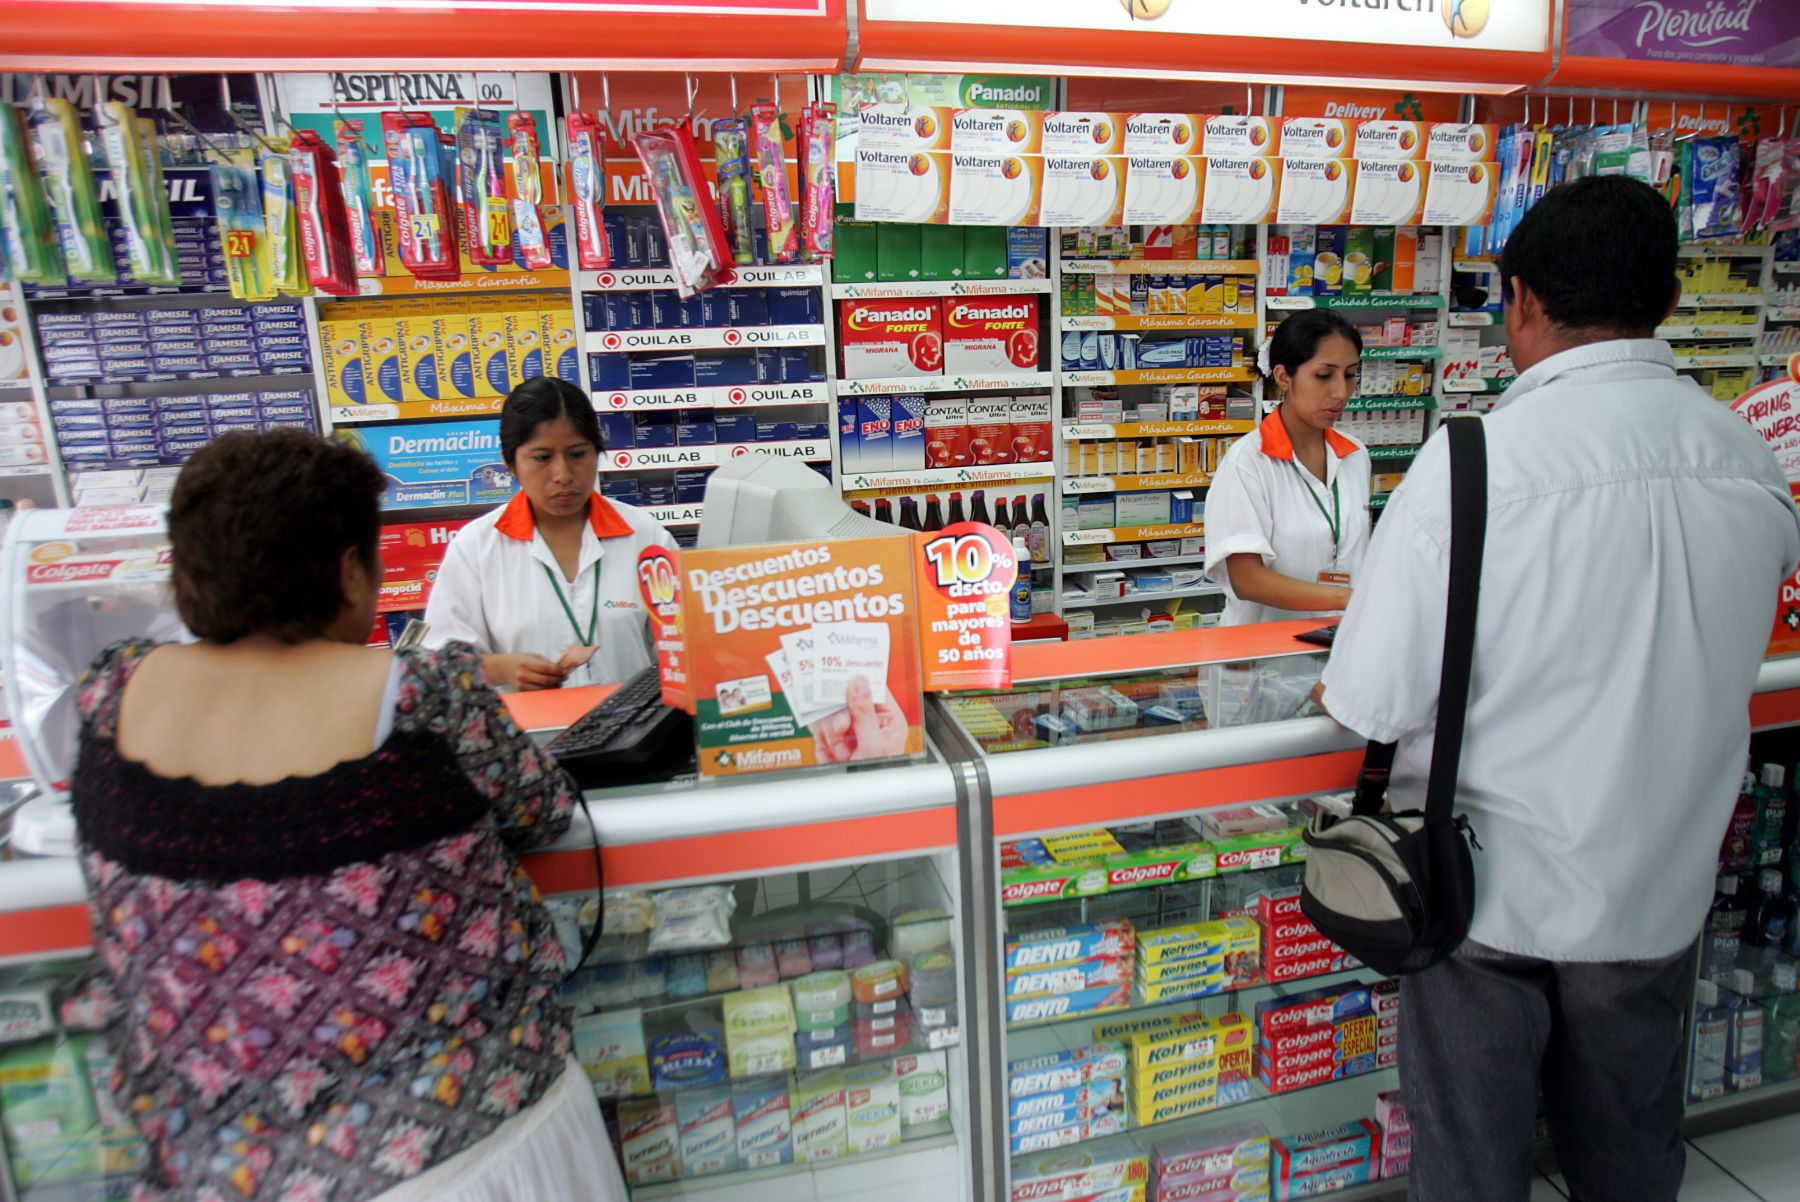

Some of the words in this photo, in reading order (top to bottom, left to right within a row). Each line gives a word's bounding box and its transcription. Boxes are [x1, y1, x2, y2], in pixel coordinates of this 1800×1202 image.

[1634, 1, 1754, 47] Plenitud
[333, 73, 464, 104] ASPIRINA
[971, 83, 1041, 102] Panadol
[1324, 101, 1386, 120] Delivery
[861, 113, 911, 127] Voltaren
[954, 118, 1003, 131] Voltaren
[1044, 122, 1089, 134] Voltaren
[1283, 126, 1324, 138] Voltaren
[1357, 129, 1397, 141] Voltaren
[860, 151, 907, 164] Voltaren
[955, 155, 1001, 168] Voltaren
[1047, 159, 1090, 170] Voltaren
[1286, 159, 1324, 170] Voltaren
[1361, 161, 1398, 172] Voltaren
[768, 191, 780, 232] Colgate
[808, 186, 822, 229] Colgate
[303, 220, 315, 261] Colgate
[621, 274, 679, 285] QUILA
[743, 271, 807, 283] QUILAB
[860, 288, 903, 297] Mifarma
[966, 285, 1007, 294] Mifarma
[855, 306, 932, 323] Panadol
[956, 304, 1029, 320] Panadol
[885, 323, 928, 333] FORTE
[984, 320, 1025, 330] FORTE
[627, 334, 692, 347] QUILAB
[747, 330, 810, 342] QUILAB
[396, 320, 411, 384] ANTIGRIPINA
[432, 319, 447, 382] ANTIGRIPINA
[469, 317, 483, 380] ANTIGRIPINA
[541, 314, 554, 377] ANTIGRIPINA
[321, 325, 337, 388] ANTIGRIPINA
[969, 379, 1009, 389] Mifarma
[633, 393, 697, 405] QUILAB
[752, 388, 814, 402] QUILAB
[924, 406, 965, 416] CONTAC
[968, 404, 1007, 414] CONTAC
[1010, 402, 1049, 413] CONTAC
[862, 419, 890, 434] ENO
[895, 418, 923, 432] ENO
[637, 452, 701, 465] QUILAB
[869, 477, 911, 487] Mifarma
[688, 545, 831, 592] Descuentos
[924, 534, 1012, 587] 10%
[32, 564, 112, 581] Colgate
[702, 564, 884, 614] Descuentos
[948, 580, 1009, 598] dscto.
[713, 592, 905, 635] Descuentos
[947, 601, 986, 618] para
[931, 616, 1005, 633] mayores
[958, 631, 981, 646] de
[821, 656, 842, 668] 10%
[938, 648, 960, 664] 50
[963, 645, 1004, 661] años
[736, 749, 802, 768] Mifarma
[1112, 864, 1171, 883] Colgate
[1275, 923, 1318, 939] Colga
[1015, 940, 1081, 968] DENTO
[1274, 939, 1331, 959] Colgate
[1274, 958, 1330, 978] Colgate
[1012, 998, 1070, 1022] DENTO
[1101, 1017, 1172, 1037] Kolynos
[1149, 1020, 1211, 1042] Kolynos
[1343, 1018, 1374, 1040] OFERTA
[1277, 1029, 1332, 1050] Colgate
[1343, 1037, 1374, 1058] ESPECIAL
[1219, 1049, 1250, 1070] OFERTA
[1277, 1047, 1332, 1069] Colgate
[1152, 1058, 1215, 1084] Kolynos
[1277, 1065, 1332, 1087] Colgate
[1152, 1076, 1215, 1103] Kolynos
[1152, 1095, 1215, 1121] Kolynos
[1297, 1126, 1347, 1144] Aquafresh
[1302, 1143, 1355, 1167] Aquafresh
[1166, 1178, 1227, 1201] Colgate
